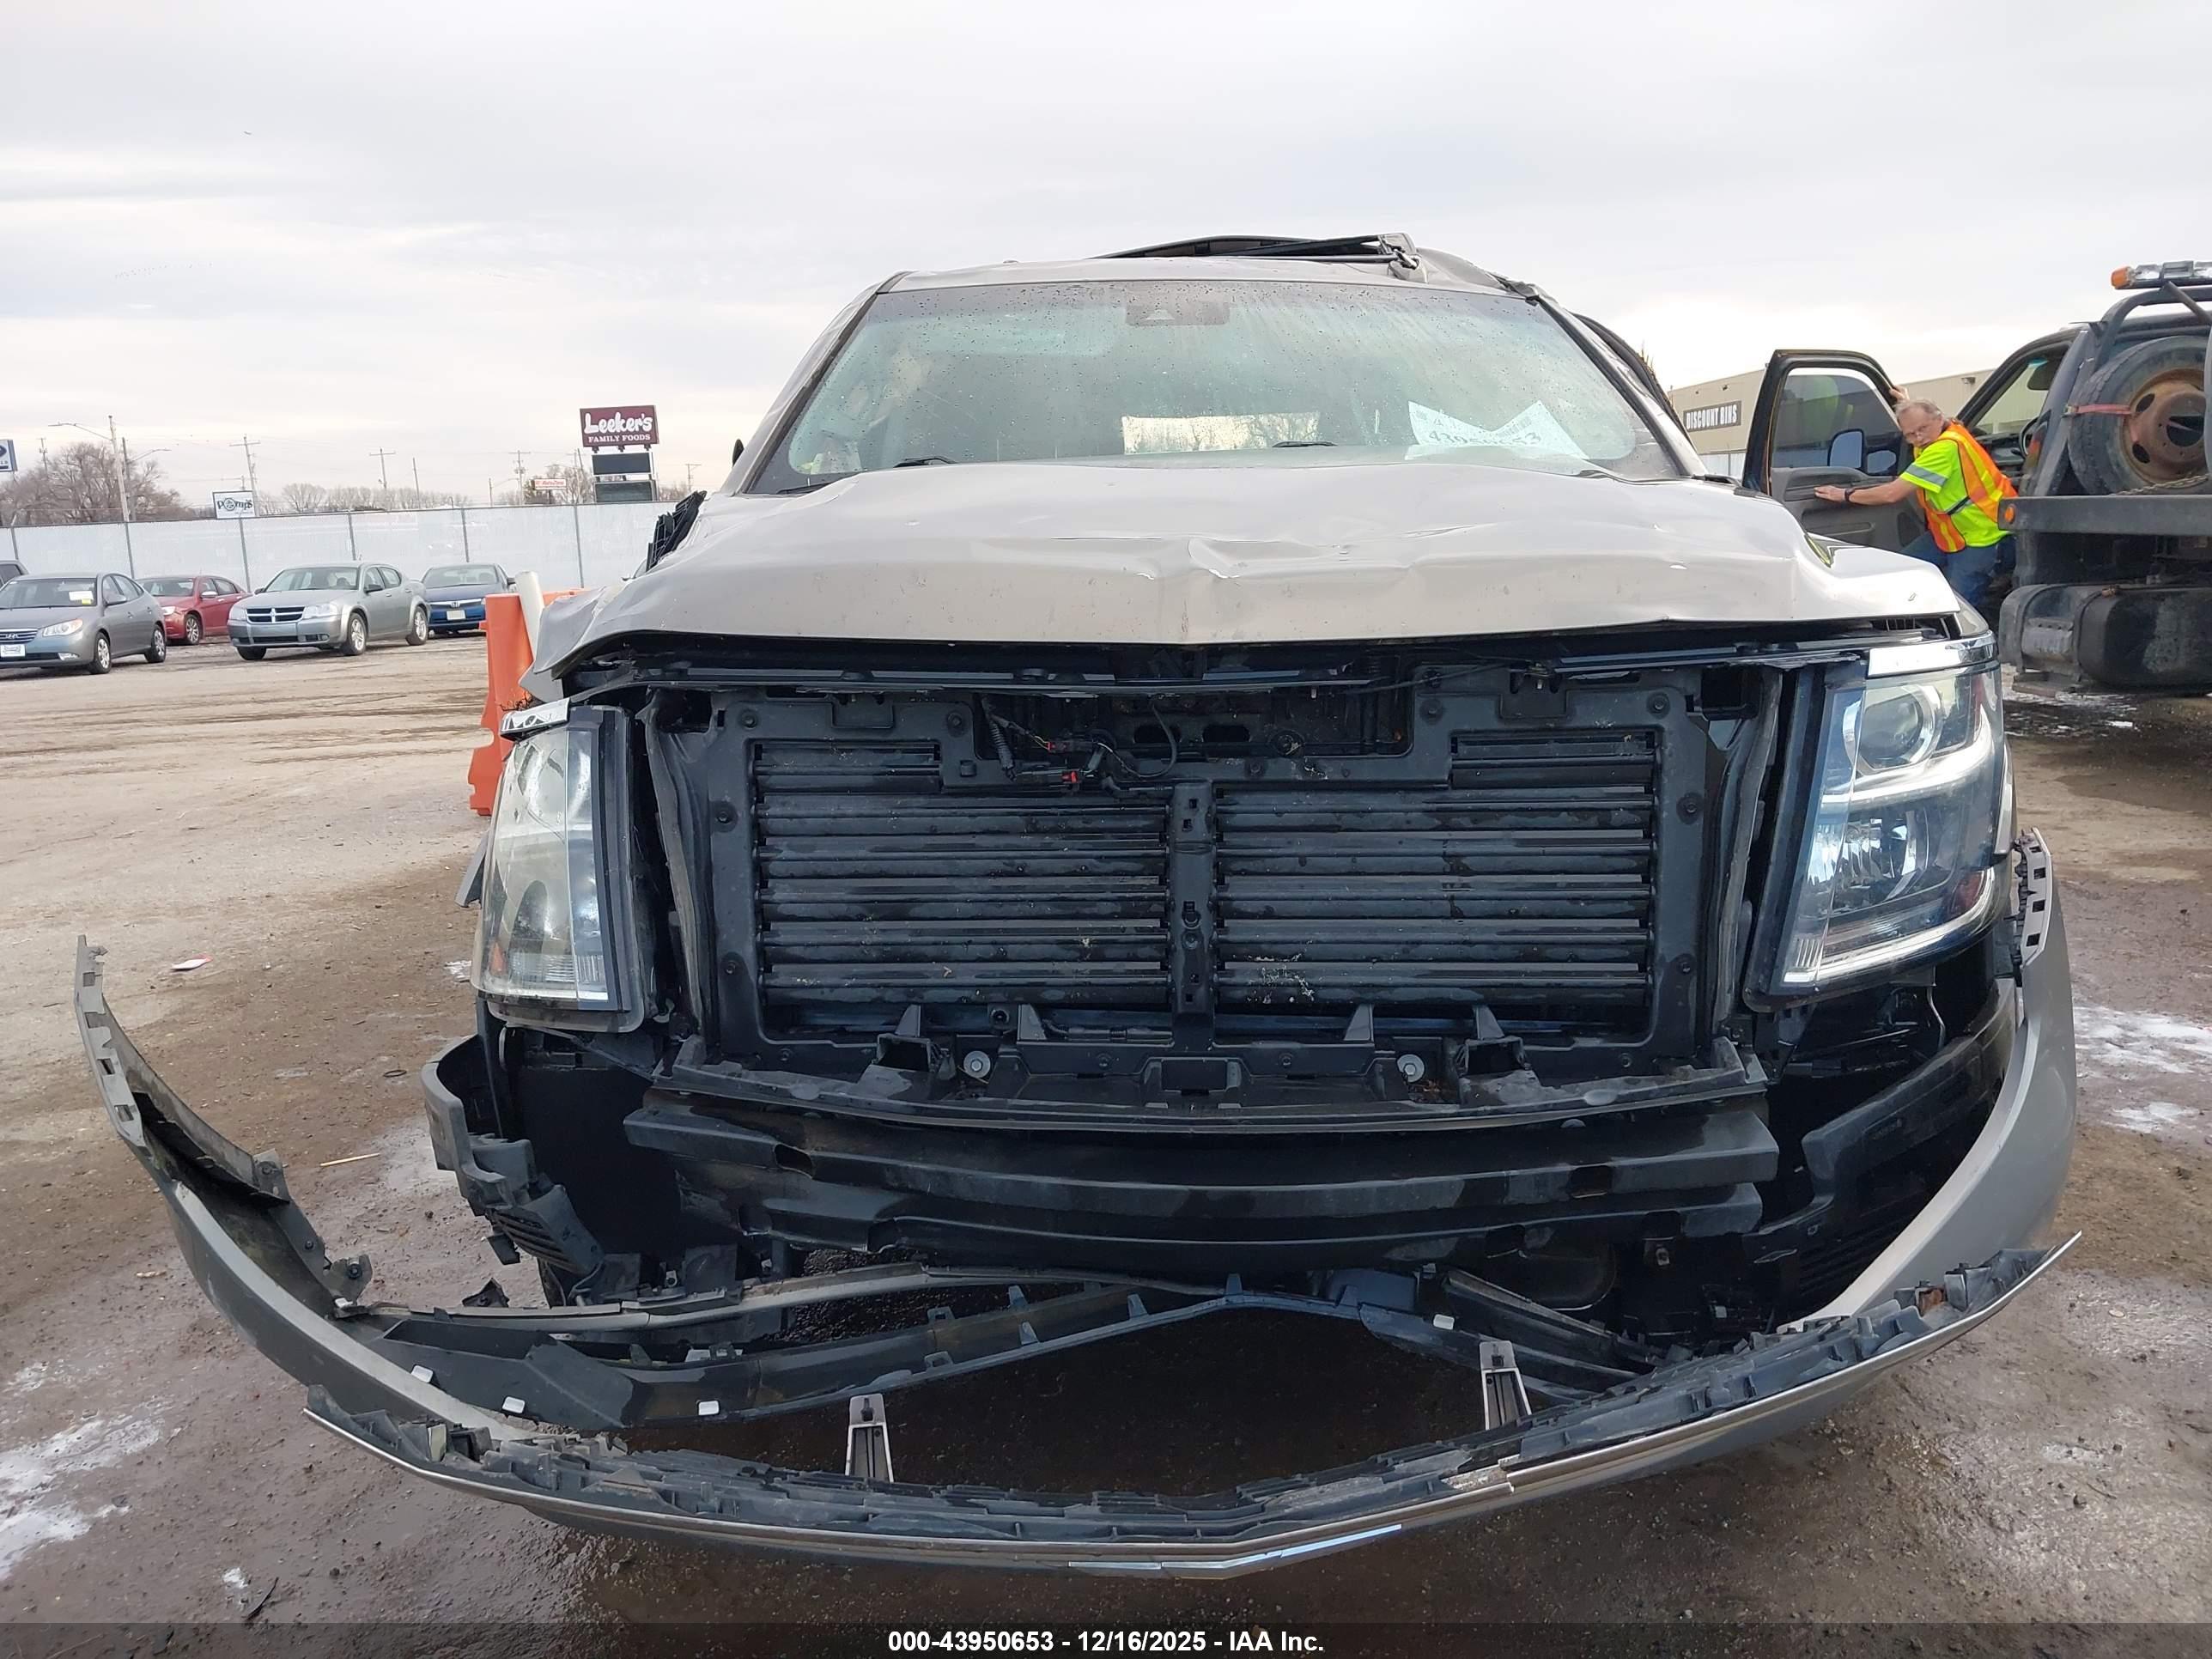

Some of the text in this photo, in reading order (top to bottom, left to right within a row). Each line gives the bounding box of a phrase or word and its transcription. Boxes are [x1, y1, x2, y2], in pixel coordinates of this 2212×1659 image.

[585, 412, 653, 434] Leeker's
[1686, 408, 1719, 429] DISCOUNT
[588, 434, 620, 443] FAMILY
